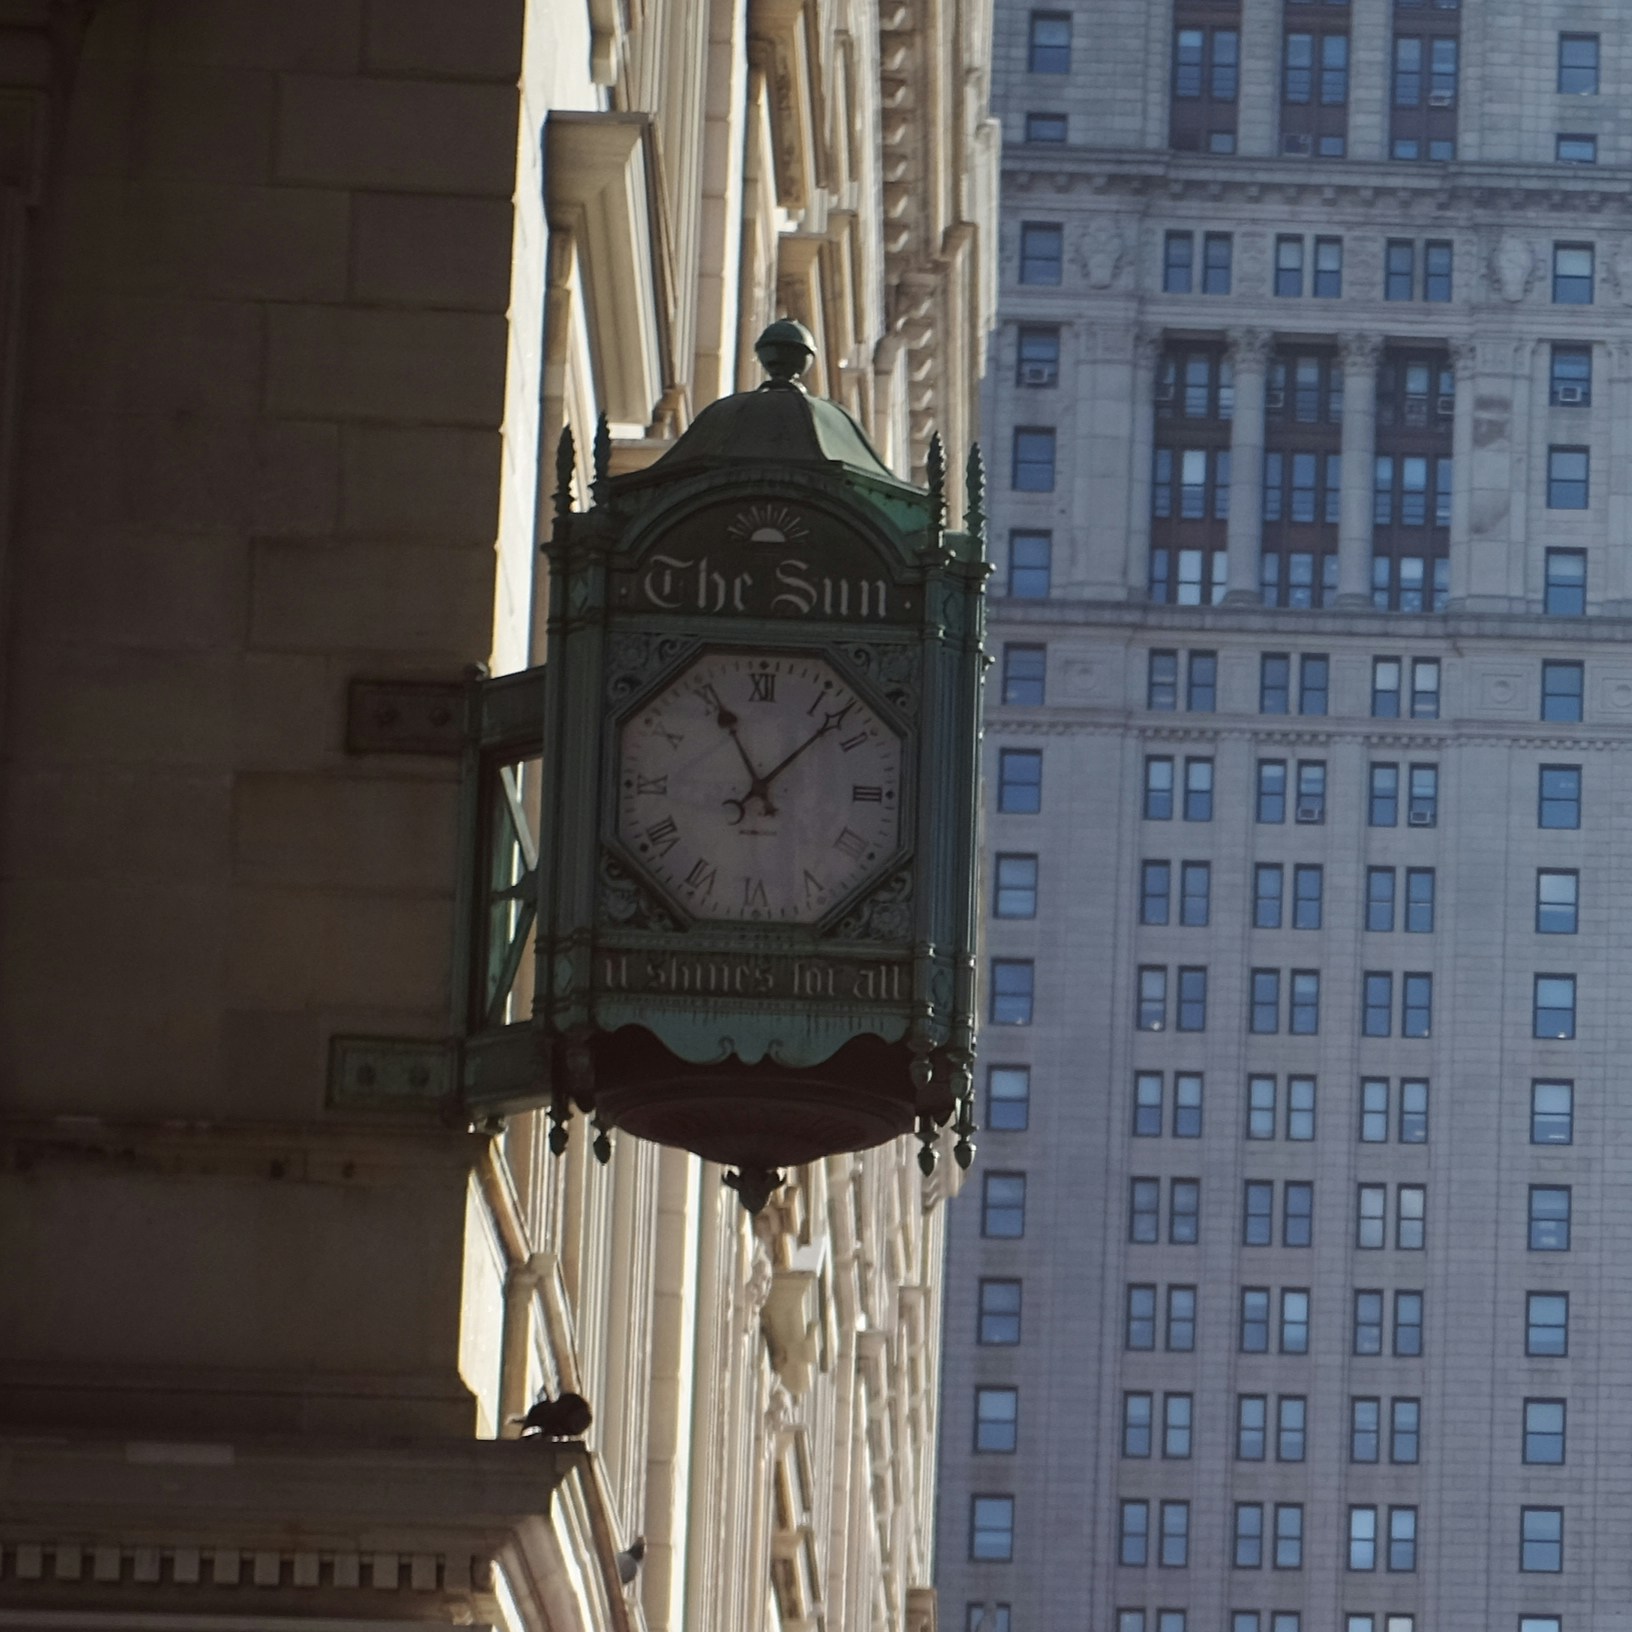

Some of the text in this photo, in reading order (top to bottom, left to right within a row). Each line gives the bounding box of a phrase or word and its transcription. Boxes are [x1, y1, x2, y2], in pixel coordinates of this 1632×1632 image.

[645, 555, 887, 618] The Sun
[749, 673, 776, 702] XII
[853, 965, 899, 999] all
